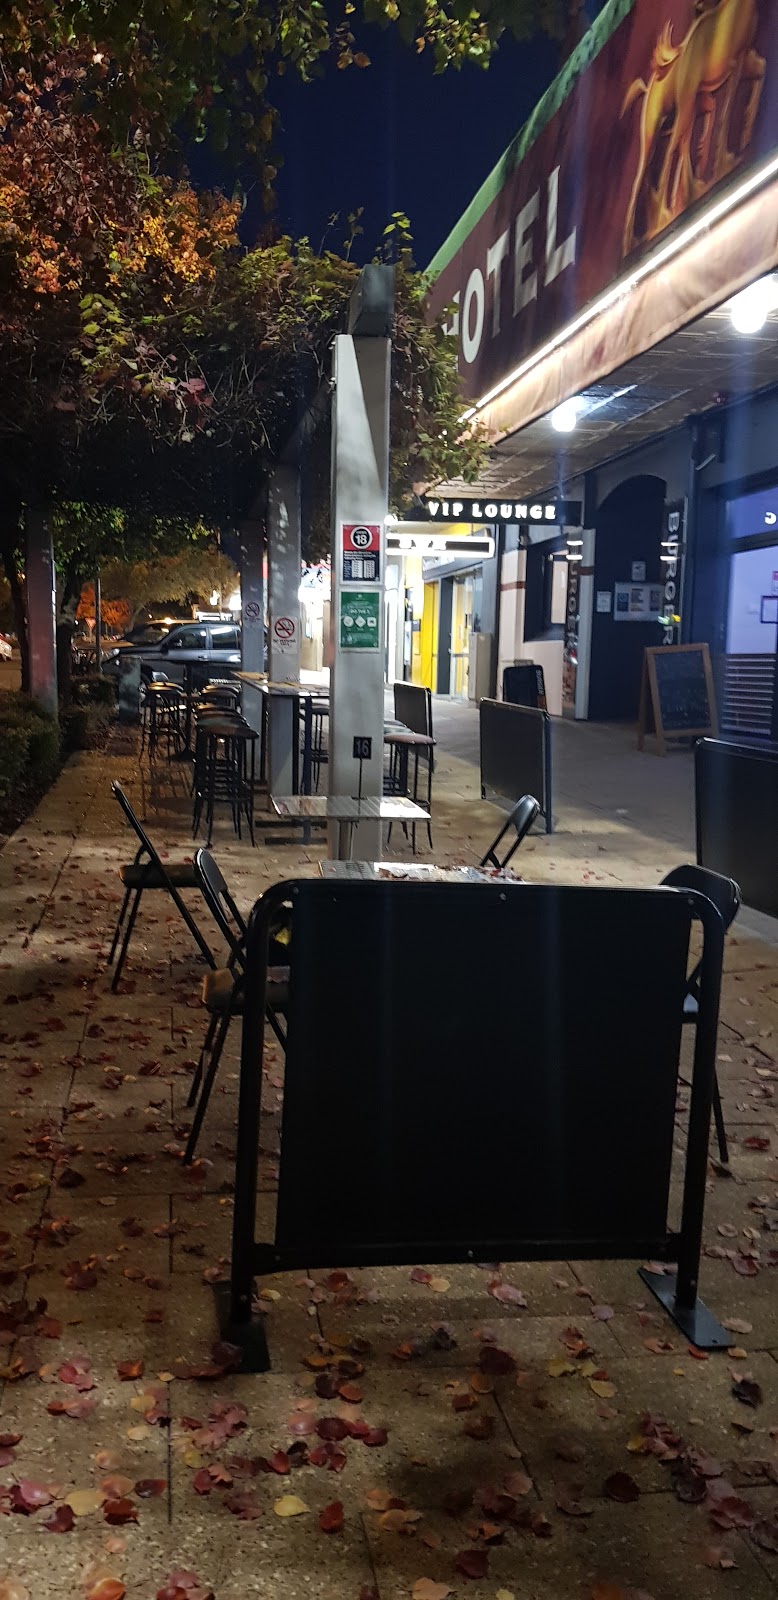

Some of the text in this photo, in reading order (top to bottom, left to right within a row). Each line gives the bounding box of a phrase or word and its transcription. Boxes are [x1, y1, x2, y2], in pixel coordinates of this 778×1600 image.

[428, 501, 556, 519] VIP LOUNGE
[355, 535, 367, 544] 18
[356, 740, 369, 756] 16
